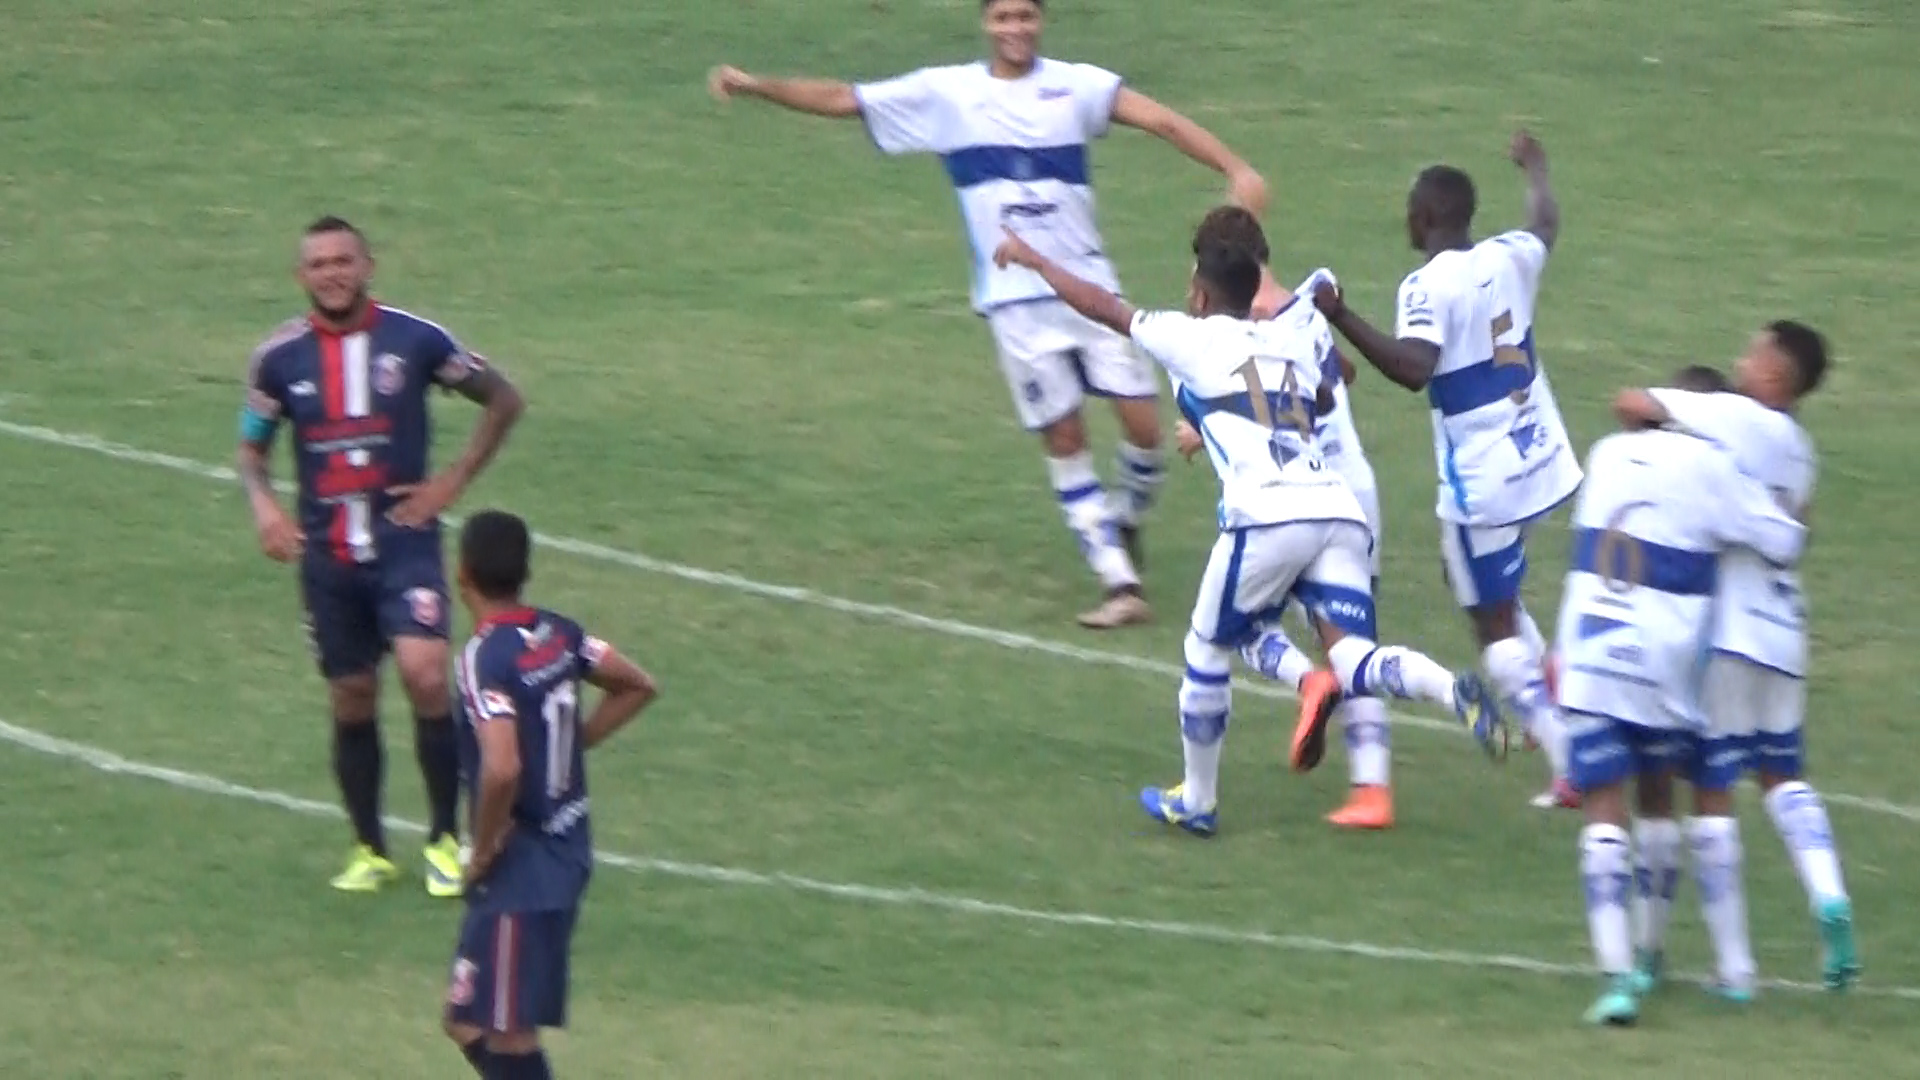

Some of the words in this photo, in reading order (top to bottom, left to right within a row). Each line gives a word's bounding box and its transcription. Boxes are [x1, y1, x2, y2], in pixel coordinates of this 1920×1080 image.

[1229, 355, 1312, 444] 14
[1490, 308, 1531, 406] 5
[541, 680, 577, 799] 17
